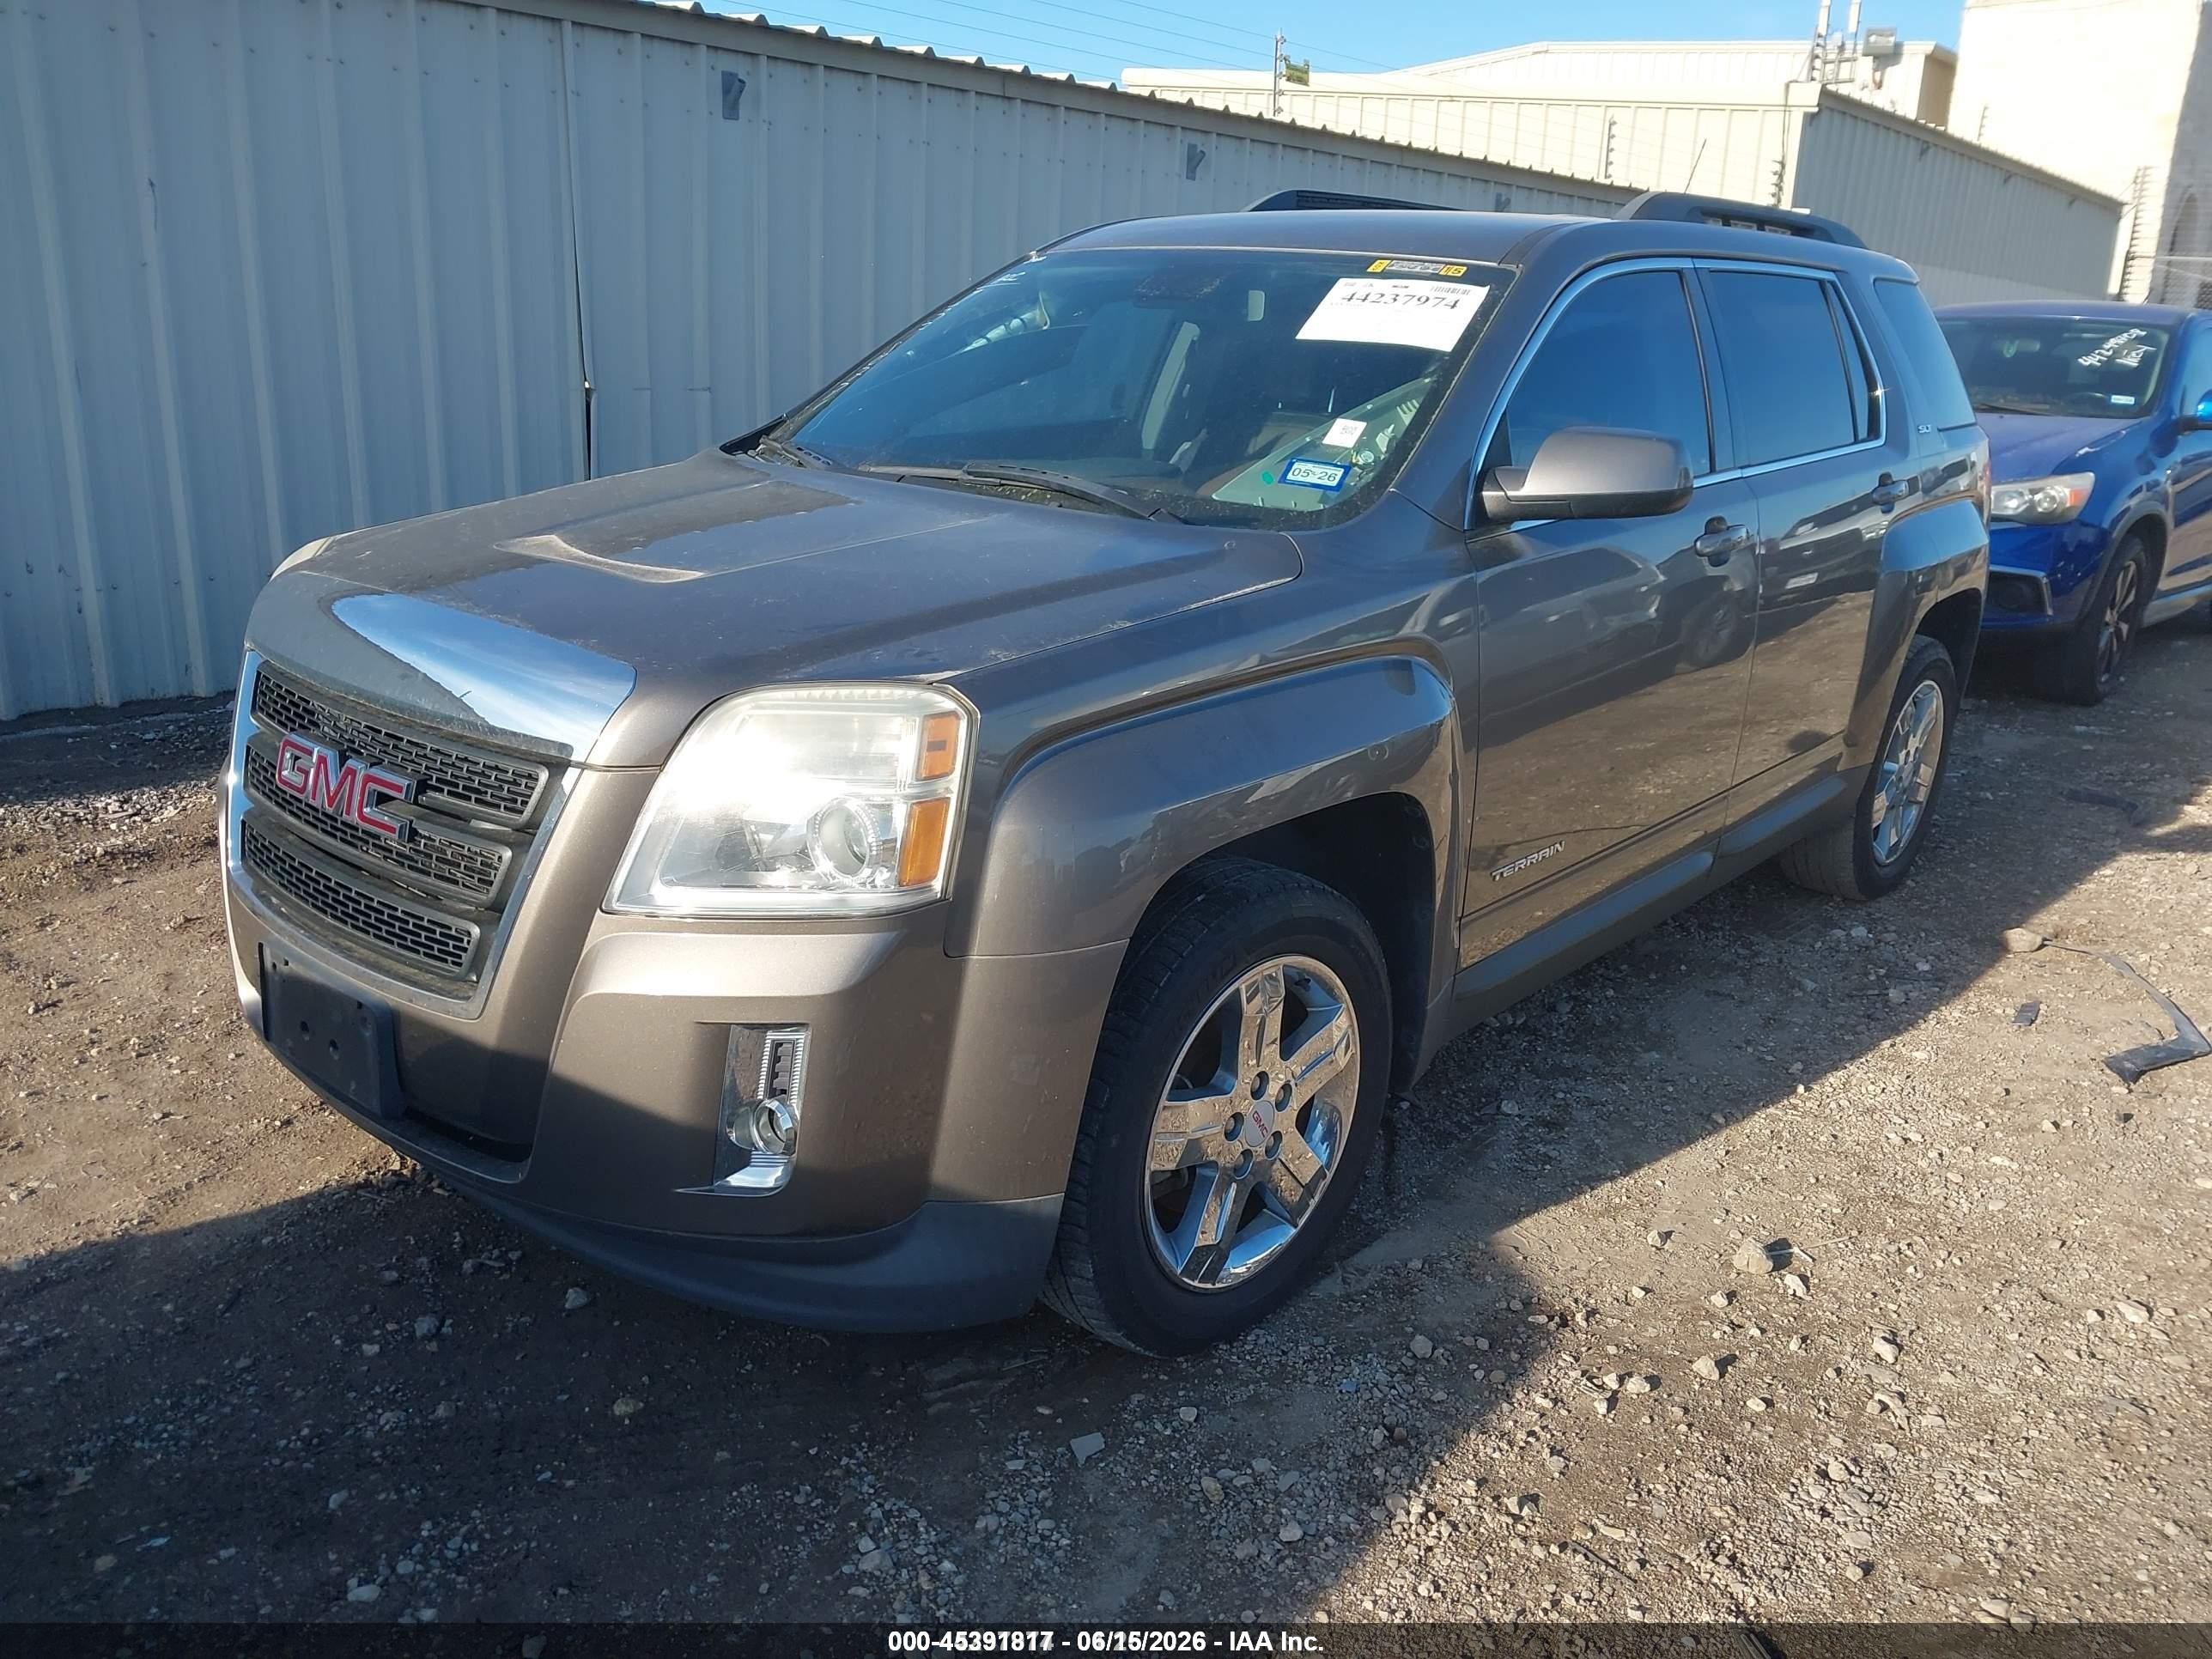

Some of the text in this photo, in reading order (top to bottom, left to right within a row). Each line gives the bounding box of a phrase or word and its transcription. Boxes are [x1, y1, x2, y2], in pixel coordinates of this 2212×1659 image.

[1341, 292, 1461, 309] 44237974
[276, 731, 415, 842] GMC
[1491, 841, 1565, 881] TERRAIN
[1252, 1110, 1268, 1138] GMC
